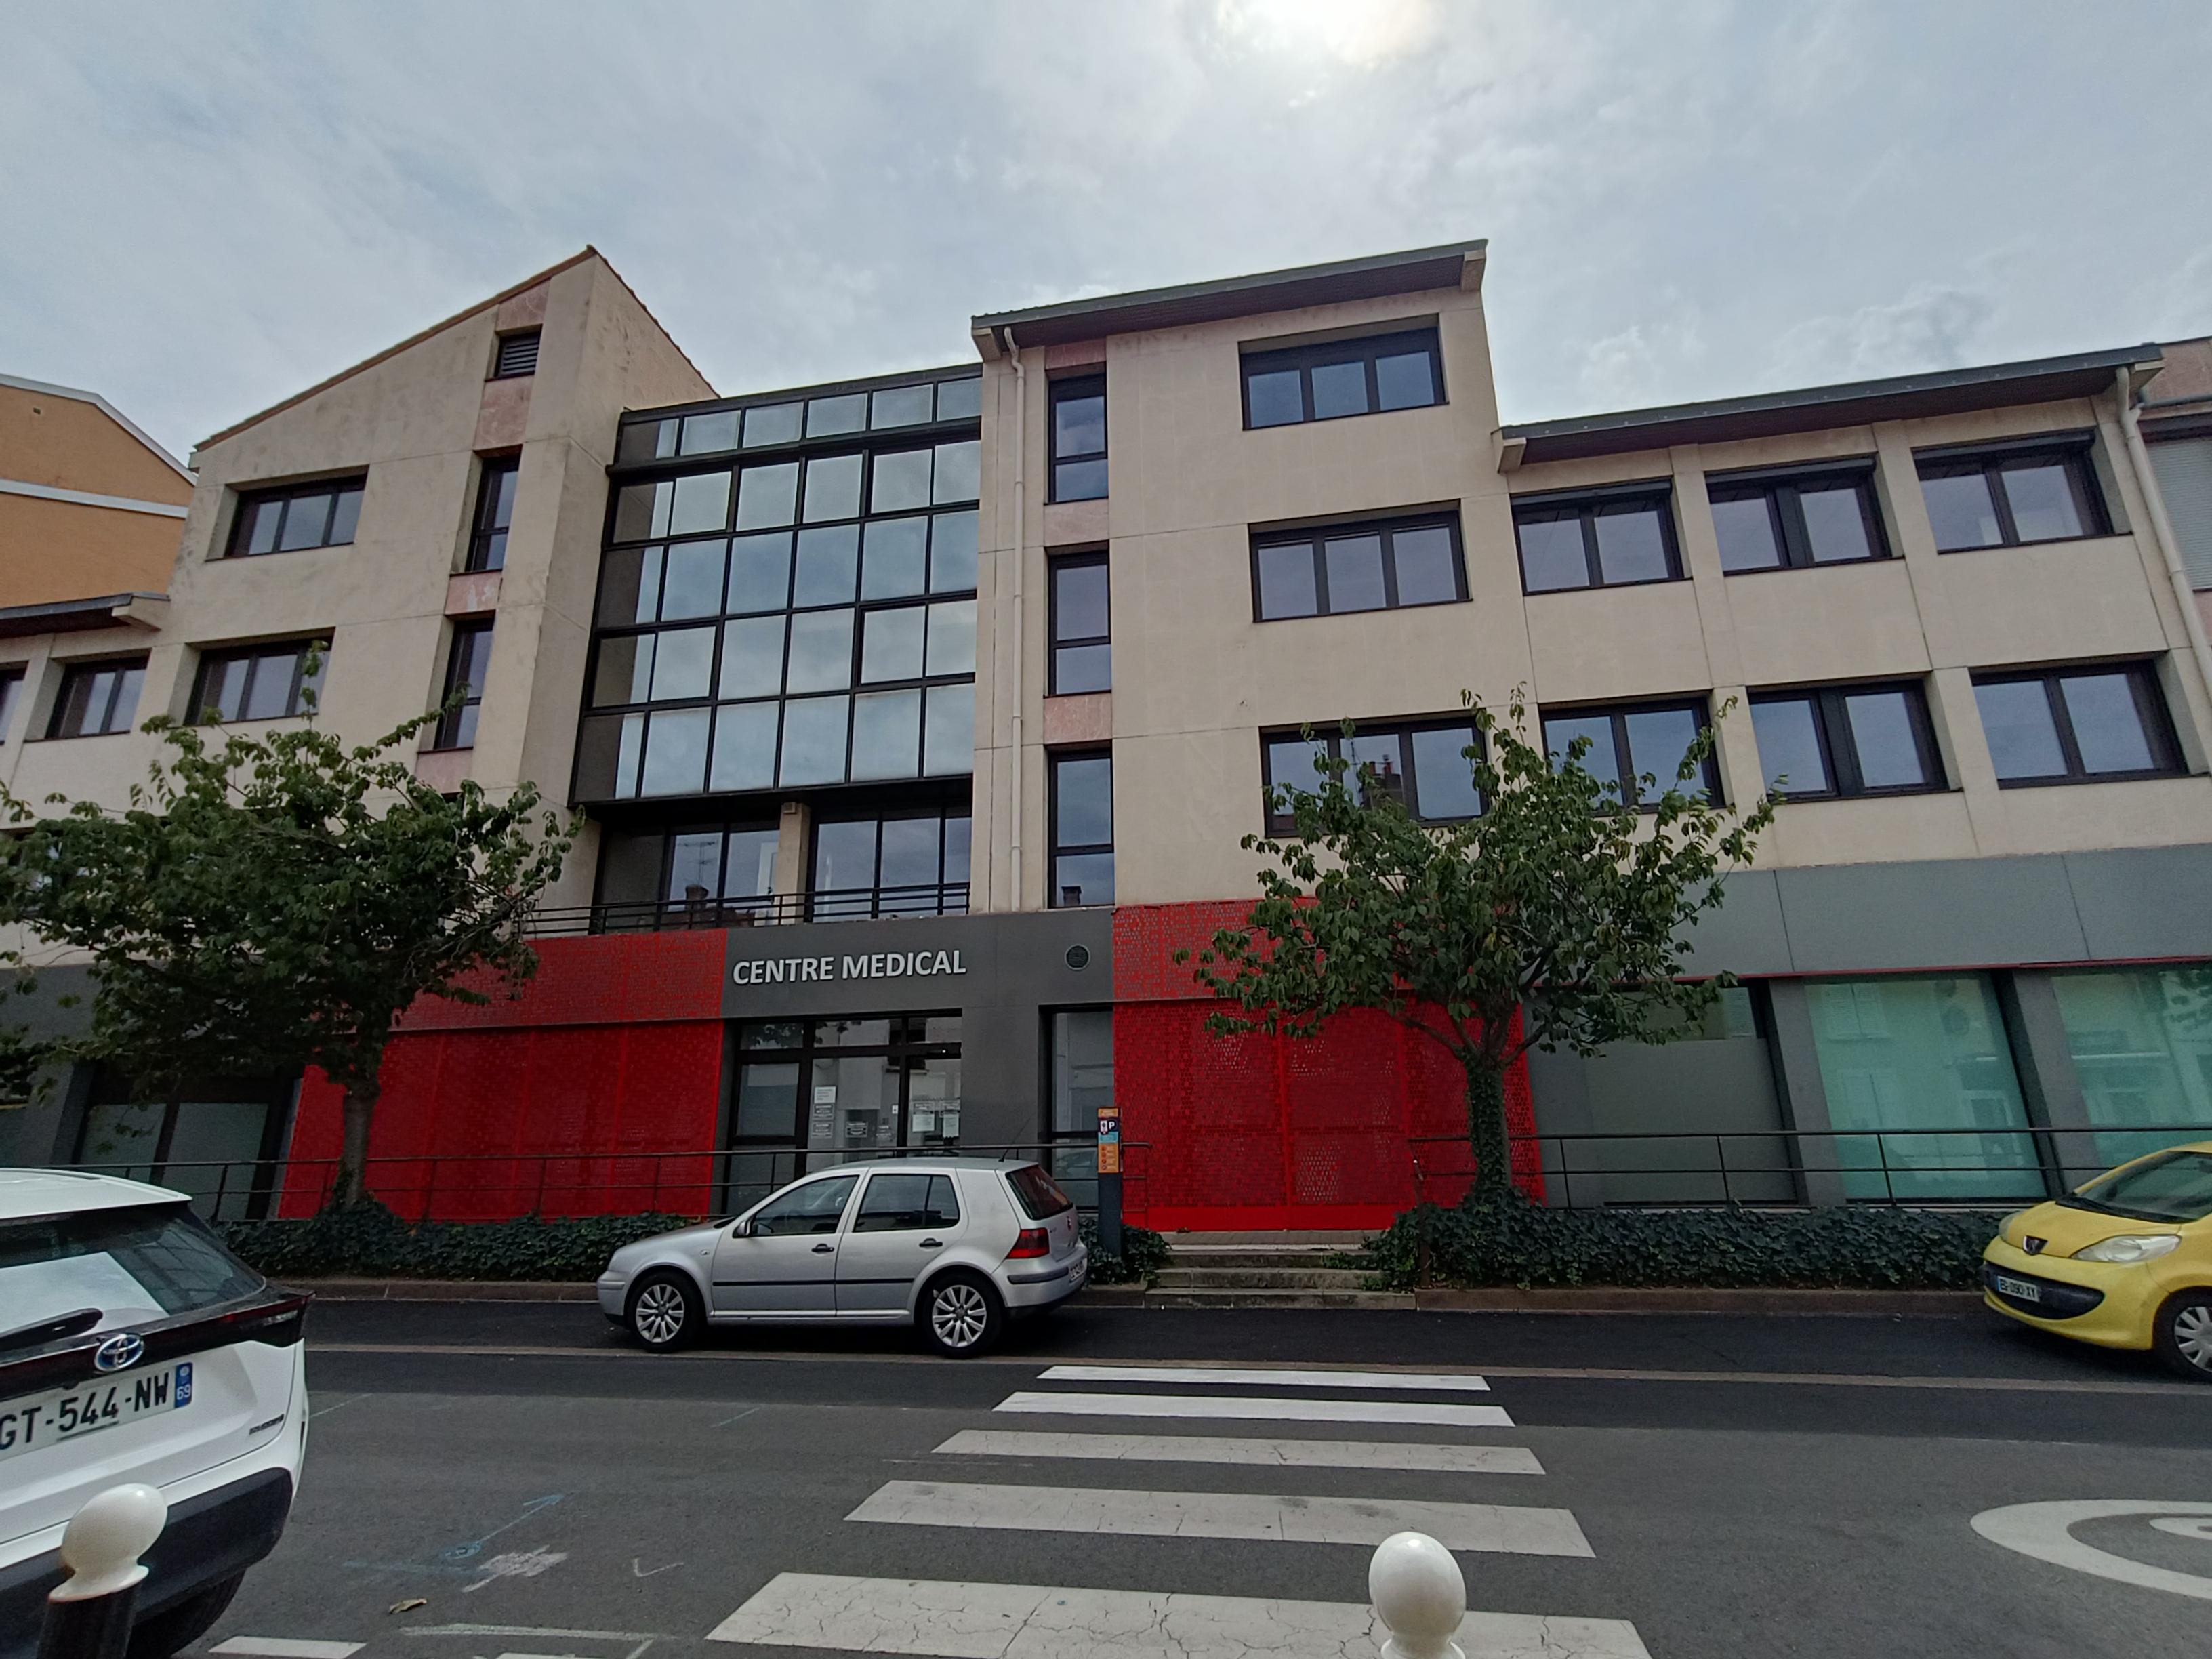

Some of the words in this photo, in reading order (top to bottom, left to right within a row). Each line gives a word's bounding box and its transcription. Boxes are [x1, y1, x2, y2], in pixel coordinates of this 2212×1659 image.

[733, 956, 834, 985] CENTRE
[842, 949, 966, 979] MEDICAL
[1108, 1121, 1115, 1130] P
[176, 1384, 191, 1401] 69
[0, 1372, 169, 1450] GT-544-NW
